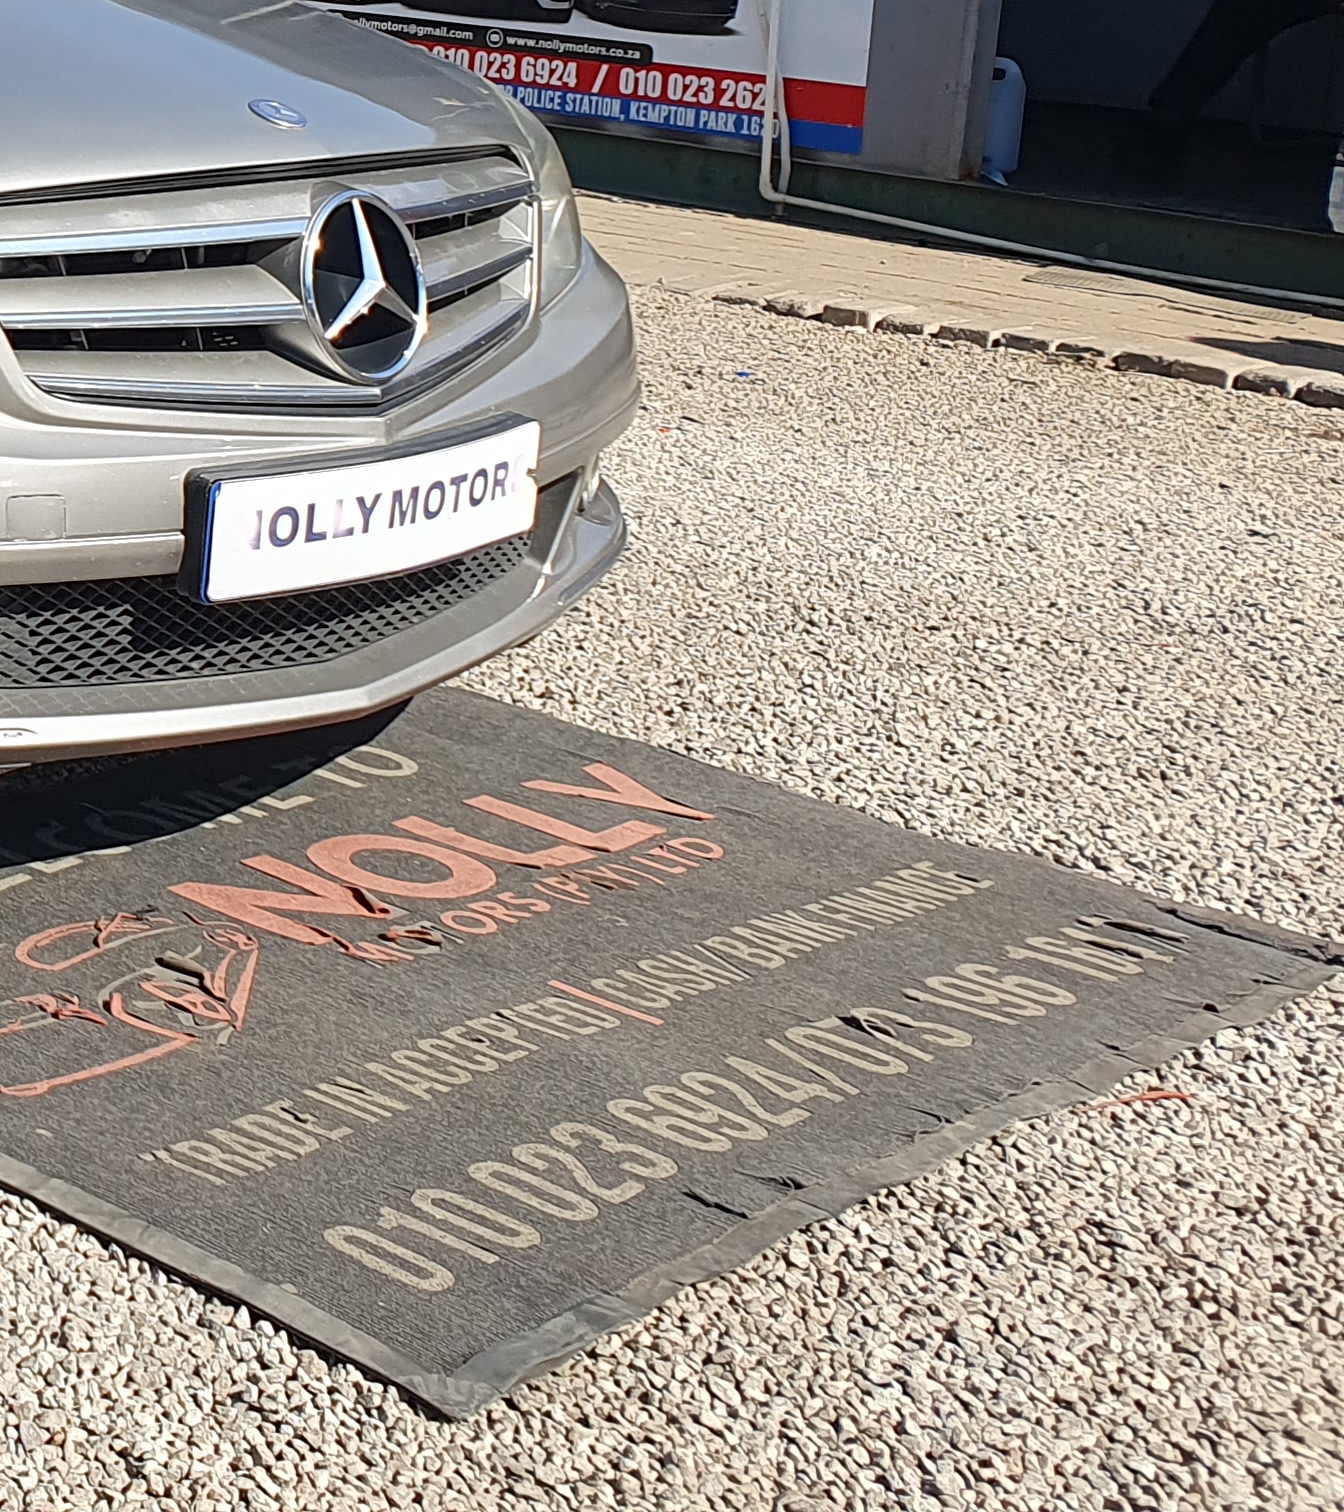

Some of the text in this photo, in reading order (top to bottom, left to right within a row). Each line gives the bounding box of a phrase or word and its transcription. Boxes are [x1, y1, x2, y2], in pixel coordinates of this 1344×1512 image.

[506, 34, 641, 61] www.nollymotors.co.za
[473, 50, 516, 80] 023
[520, 55, 578, 88] 6924
[619, 67, 662, 98] 010
[667, 73, 715, 105] 023
[719, 78, 769, 112] 262
[516, 86, 563, 110] POLICE
[565, 92, 625, 121] STATION,
[629, 101, 696, 128] KEMPTON
[699, 109, 736, 134] PARK
[740, 114, 780, 139] 160
[272, 744, 420, 789] TO
[167, 760, 717, 946] NOLLY
[630, 837, 725, 876] LTD
[138, 861, 996, 1186] TRADE IN ACCEPTED CASH/BANK FINANCE
[322, 1187, 542, 1291] 010
[467, 1121, 679, 1222] 023
[900, 962, 1078, 1026] 196
